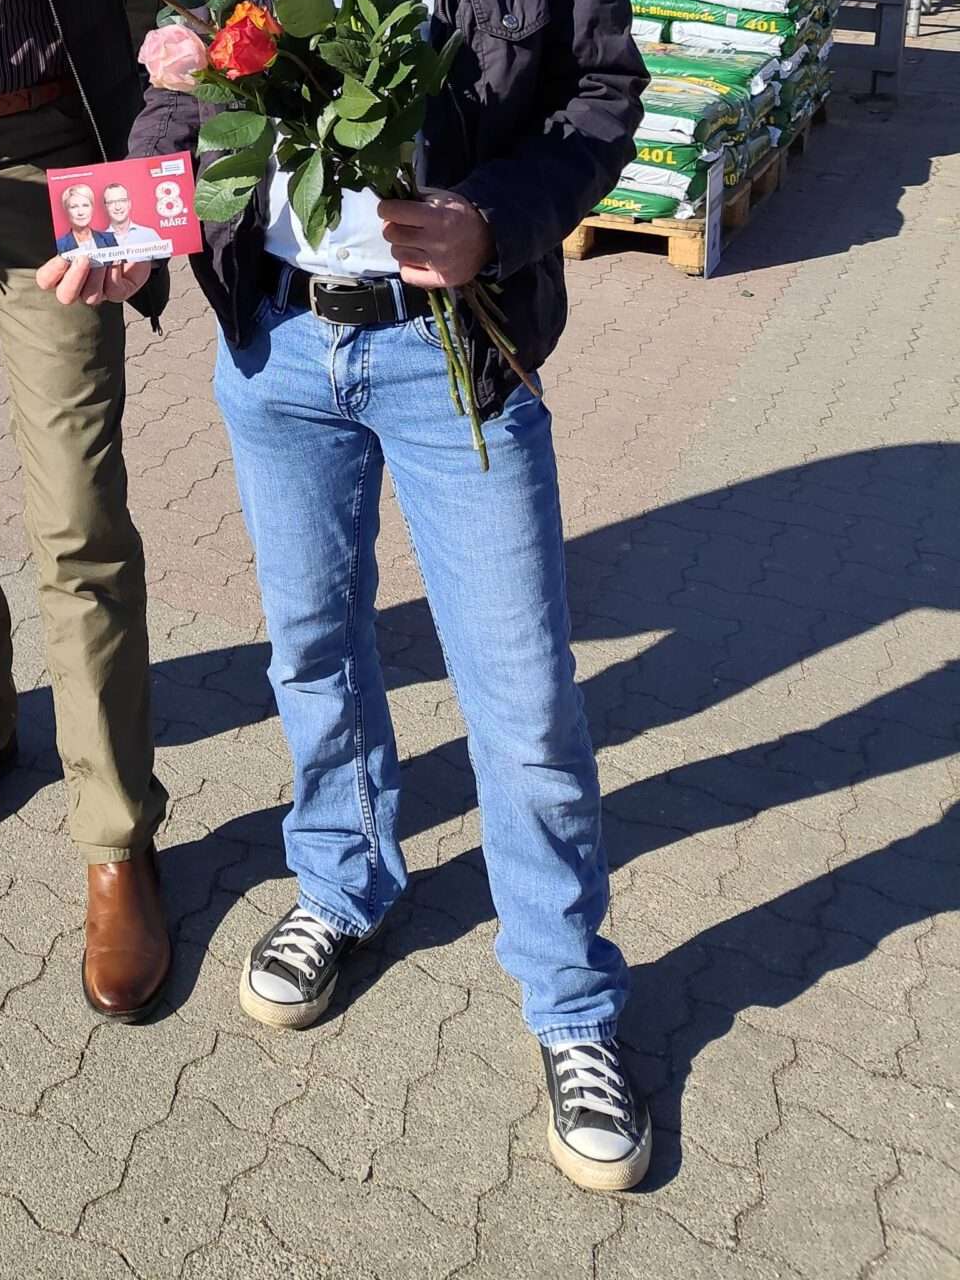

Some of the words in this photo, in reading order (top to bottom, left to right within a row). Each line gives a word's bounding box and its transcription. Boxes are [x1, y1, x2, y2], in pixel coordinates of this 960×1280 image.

[159, 216, 188, 228] MÄRZ
[108, 250, 126, 258] zum
[126, 242, 170, 256] Frauentag!
